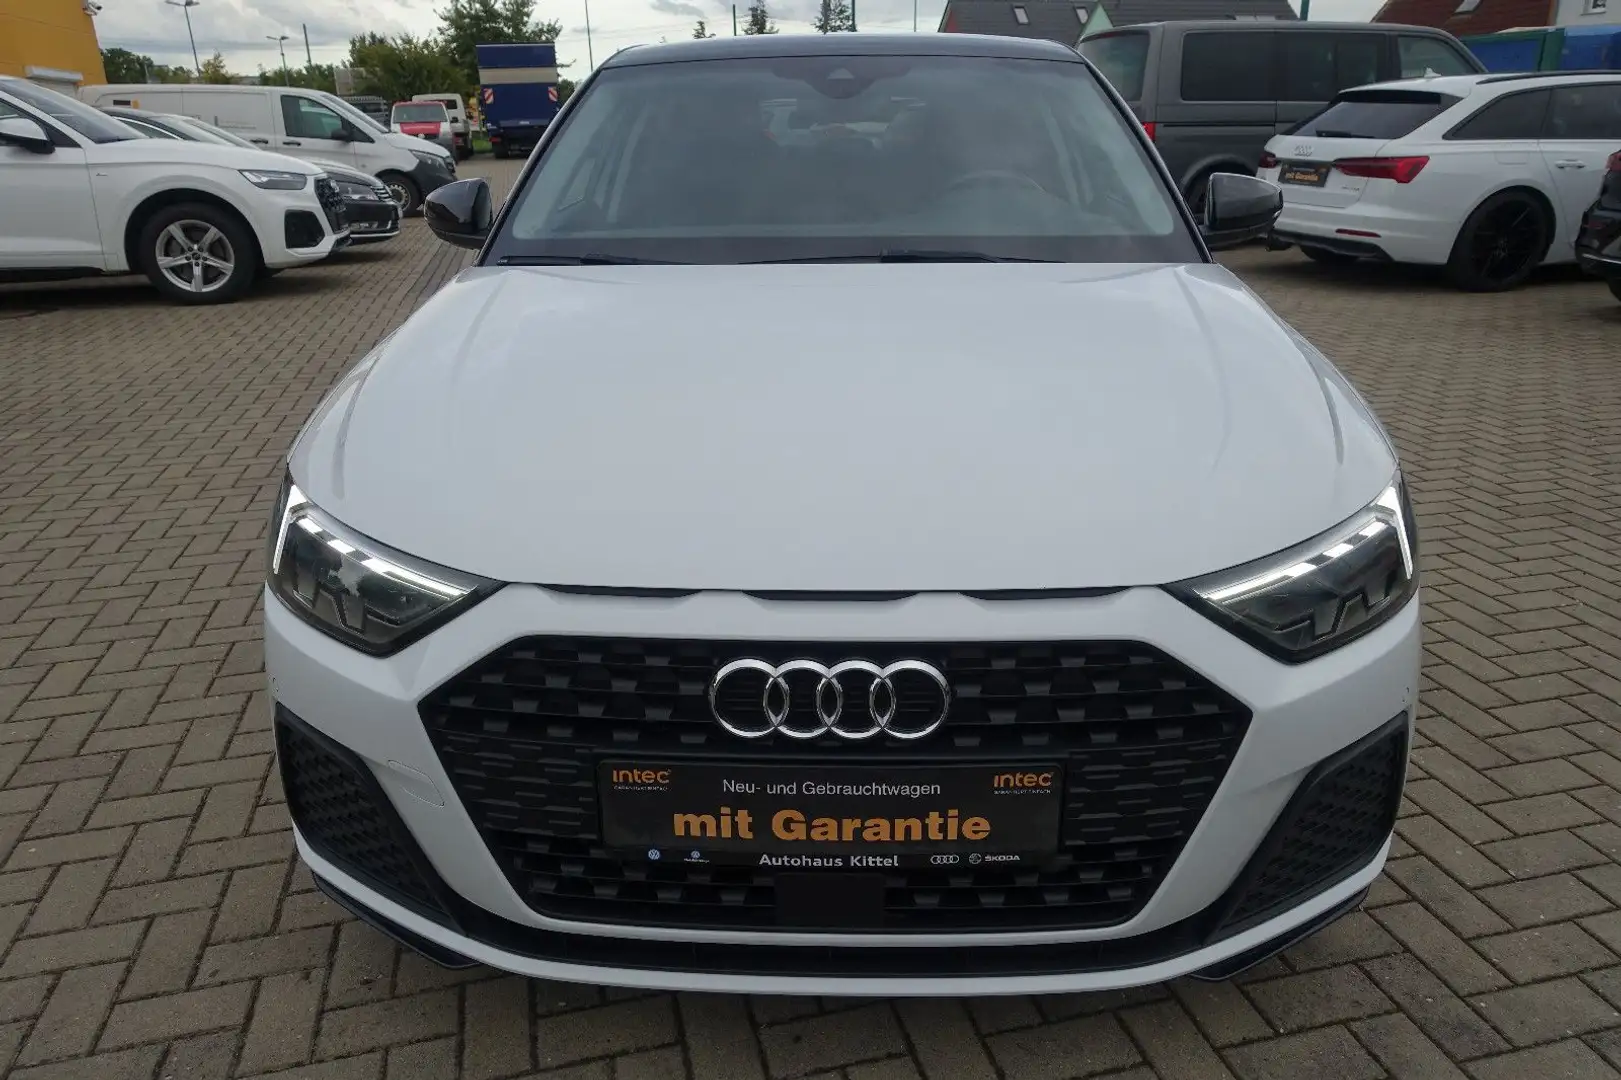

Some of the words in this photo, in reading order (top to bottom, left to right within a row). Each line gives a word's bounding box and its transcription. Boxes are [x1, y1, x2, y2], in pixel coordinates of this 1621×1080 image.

[612, 769, 670, 784] intec
[993, 772, 1051, 788] intec
[723, 779, 761, 794] Neu-
[766, 781, 797, 795] und
[802, 781, 941, 799] Gebrauchtwagen
[673, 806, 754, 839] mit
[771, 808, 991, 842] Garantie
[758, 854, 843, 867] Autohaus
[850, 855, 899, 867] Kittel
